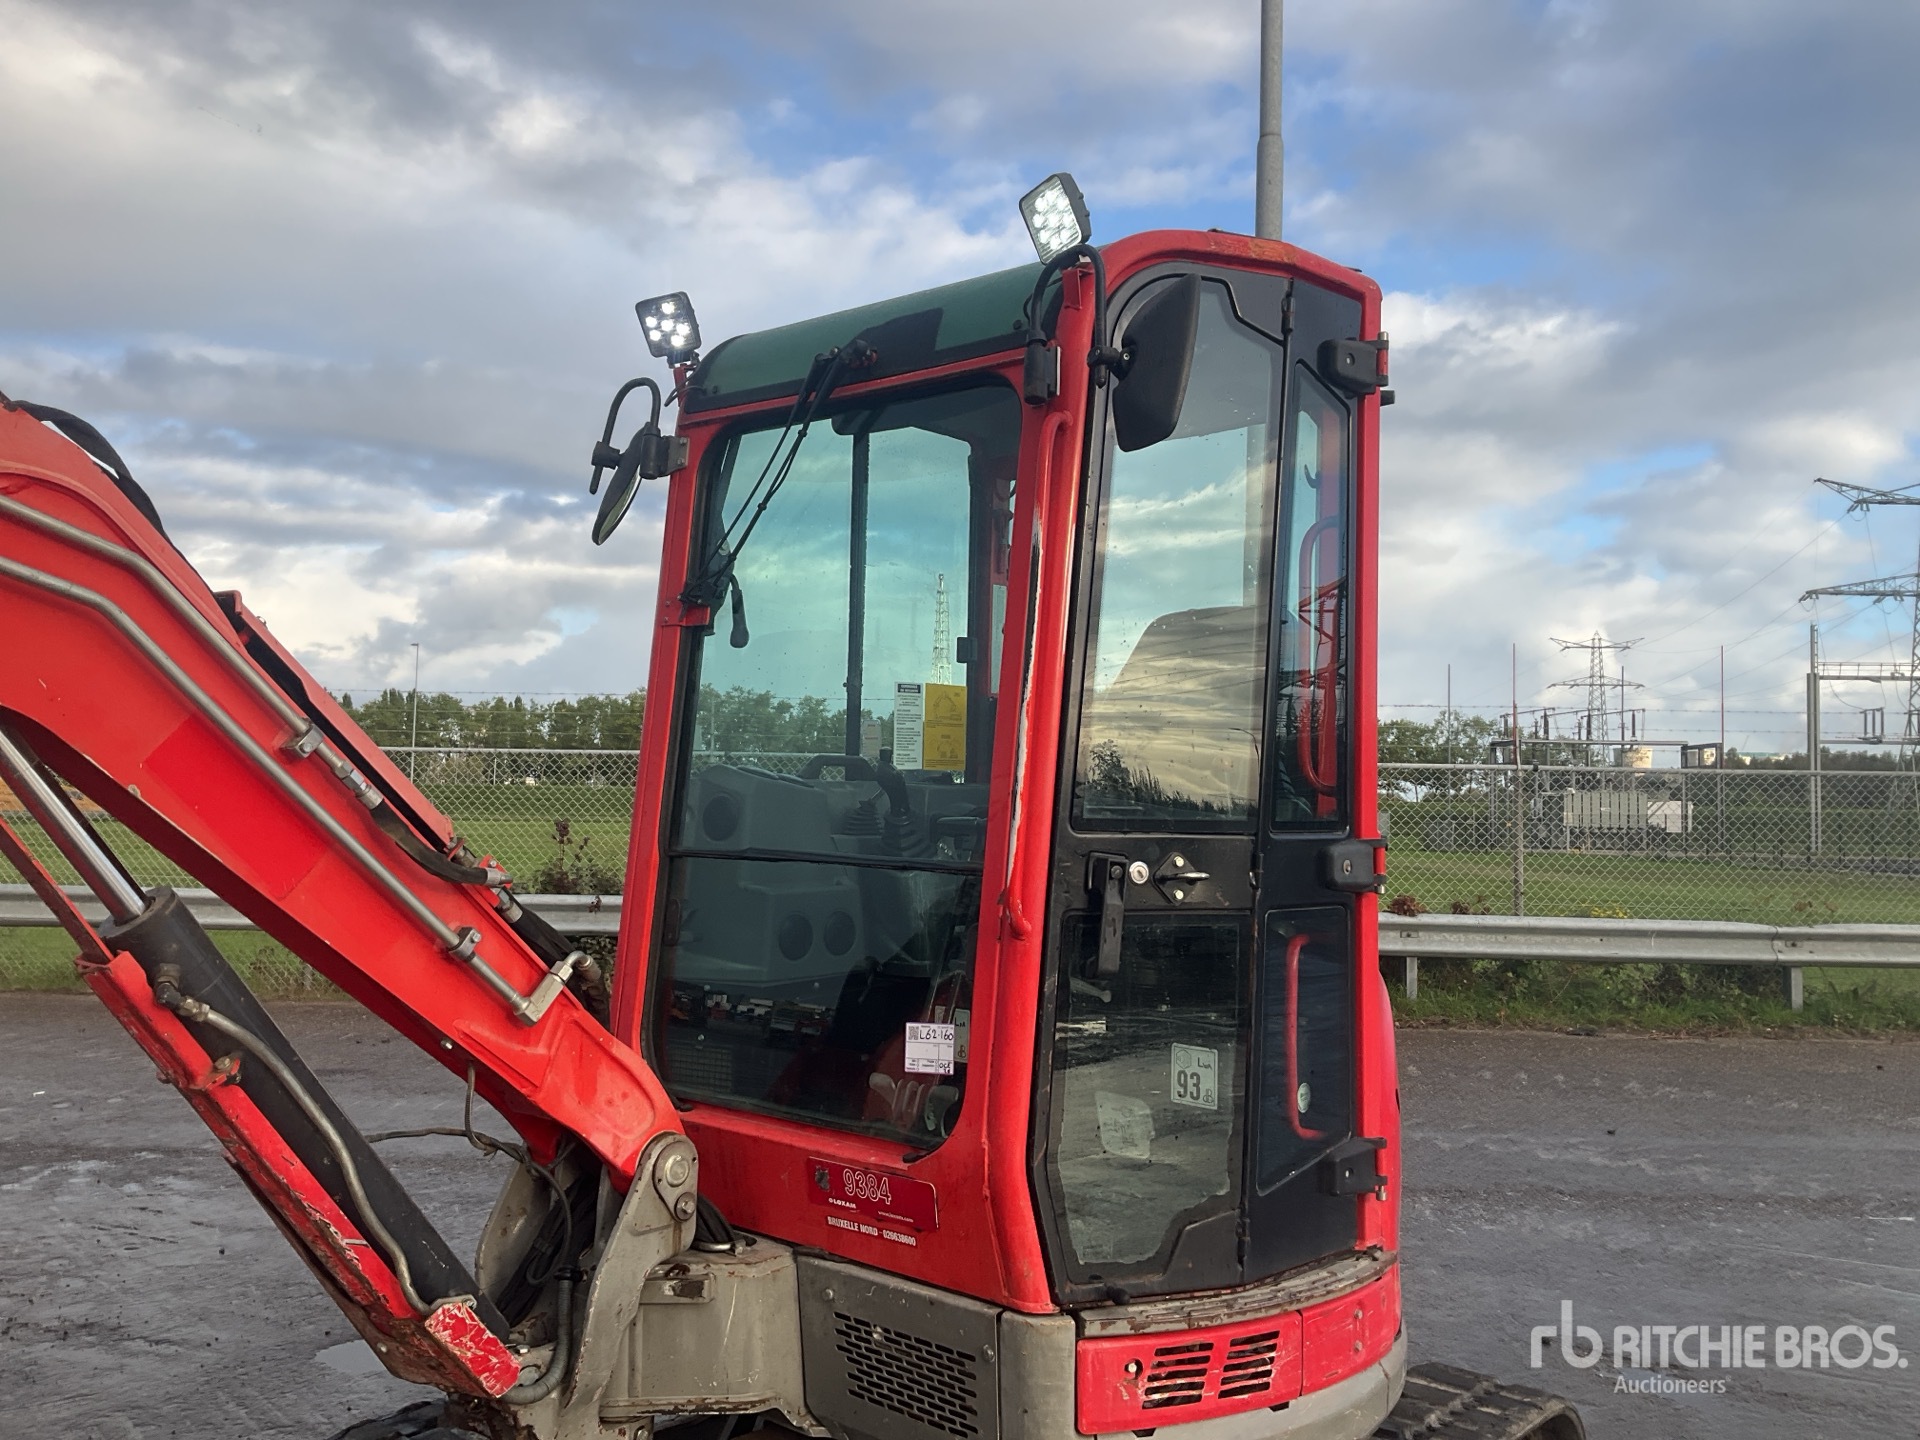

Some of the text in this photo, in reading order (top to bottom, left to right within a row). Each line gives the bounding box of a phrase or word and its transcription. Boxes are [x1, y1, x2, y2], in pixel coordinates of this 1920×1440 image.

[1177, 1070, 1201, 1101] 93
[843, 1169, 892, 1205] 9384
[833, 1199, 857, 1209] LOXAM
[827, 1216, 859, 1231] BRUXELLE
[860, 1224, 878, 1236] NORD
